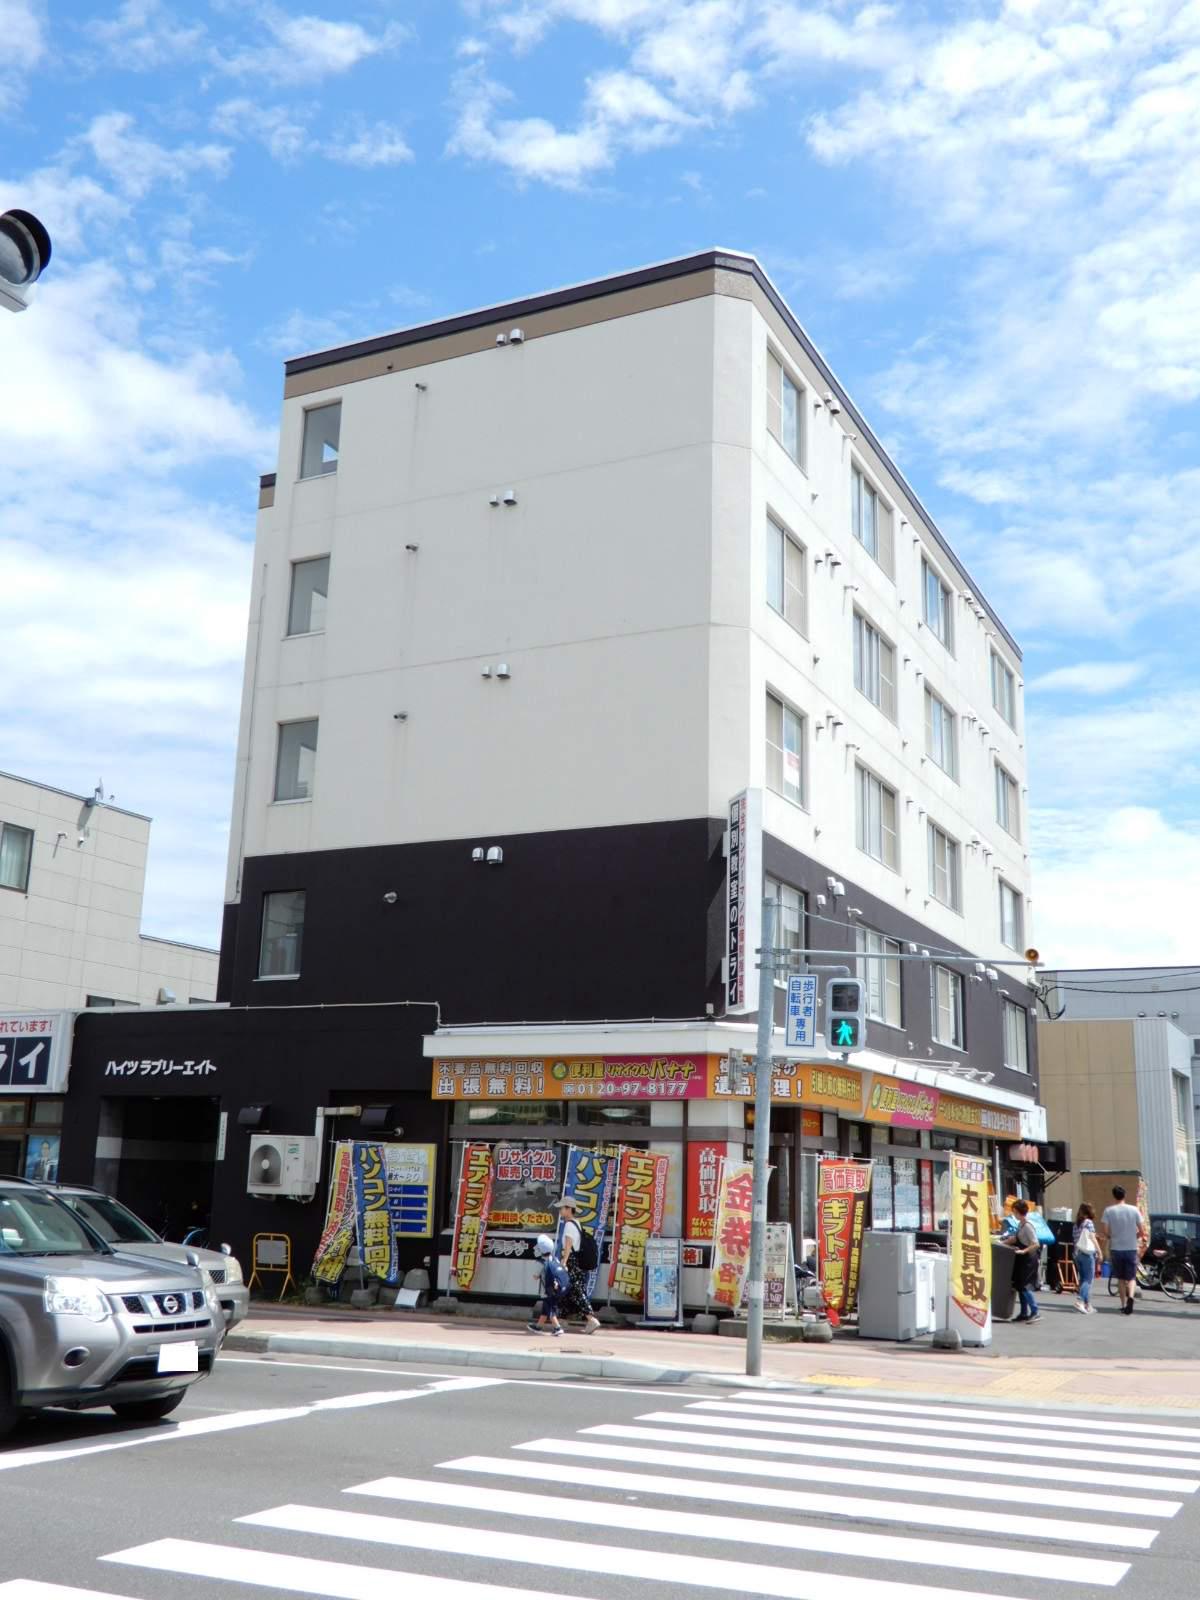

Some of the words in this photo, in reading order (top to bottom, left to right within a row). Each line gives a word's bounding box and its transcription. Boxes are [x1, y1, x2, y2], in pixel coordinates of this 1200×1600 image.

[790, 980, 801, 1016] 自転車
[803, 980, 814, 1016] 歩行者
[794, 1017, 807, 1042] 専用
[439, 1061, 544, 1075] 不要品無料回収
[577, 1081, 688, 1096] 0120-97-8177
[714, 1075, 803, 1098] 遺品理!
[498, 1149, 556, 1164] リサイクル
[497, 1165, 556, 1181] 販売・買取
[823, 1167, 868, 1191] 高価買取
[960, 1183, 987, 1302] 大口買取
